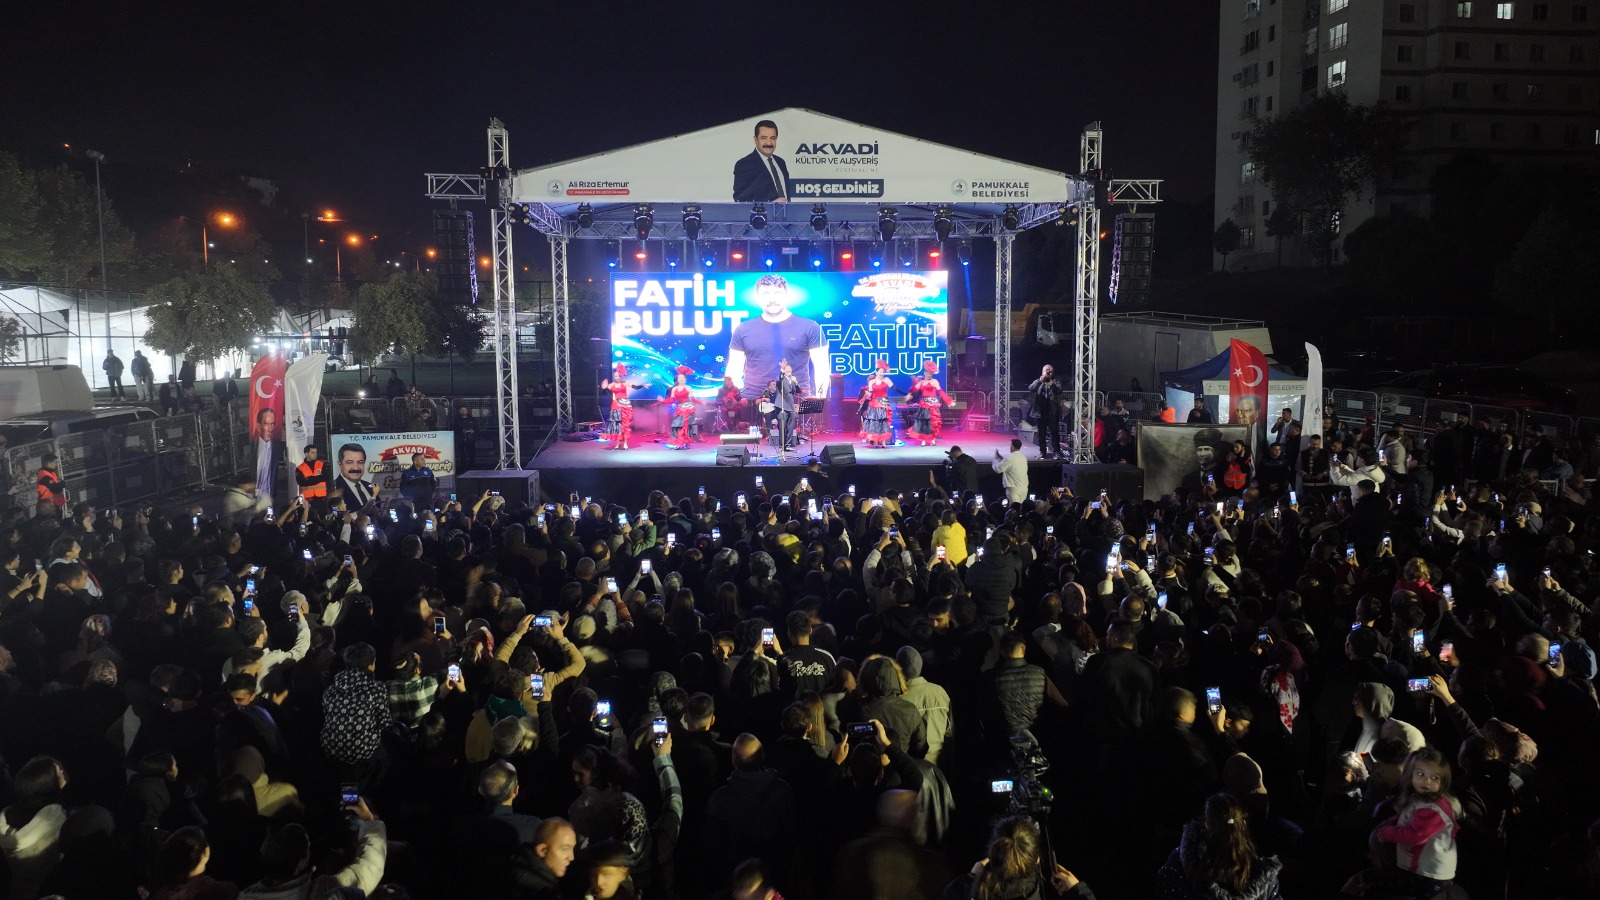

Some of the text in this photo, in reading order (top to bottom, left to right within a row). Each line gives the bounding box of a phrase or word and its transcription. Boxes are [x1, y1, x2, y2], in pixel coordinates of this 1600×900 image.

[795, 140, 879, 155] AKVADİ
[795, 156, 827, 165] KÜLTÜR
[839, 156, 879, 166] ALIŞVERİŞ
[795, 181, 880, 196] HOŞ GELDİNİZ
[971, 181, 1030, 189] PAMUKKALE
[972, 189, 1029, 198] BELEDİYESİ
[614, 272, 735, 307] FATİH
[614, 310, 749, 336] BULUT
[819, 316, 937, 349] FATİH
[829, 351, 947, 376] BULUT
[392, 446, 427, 455] AKVADİ
